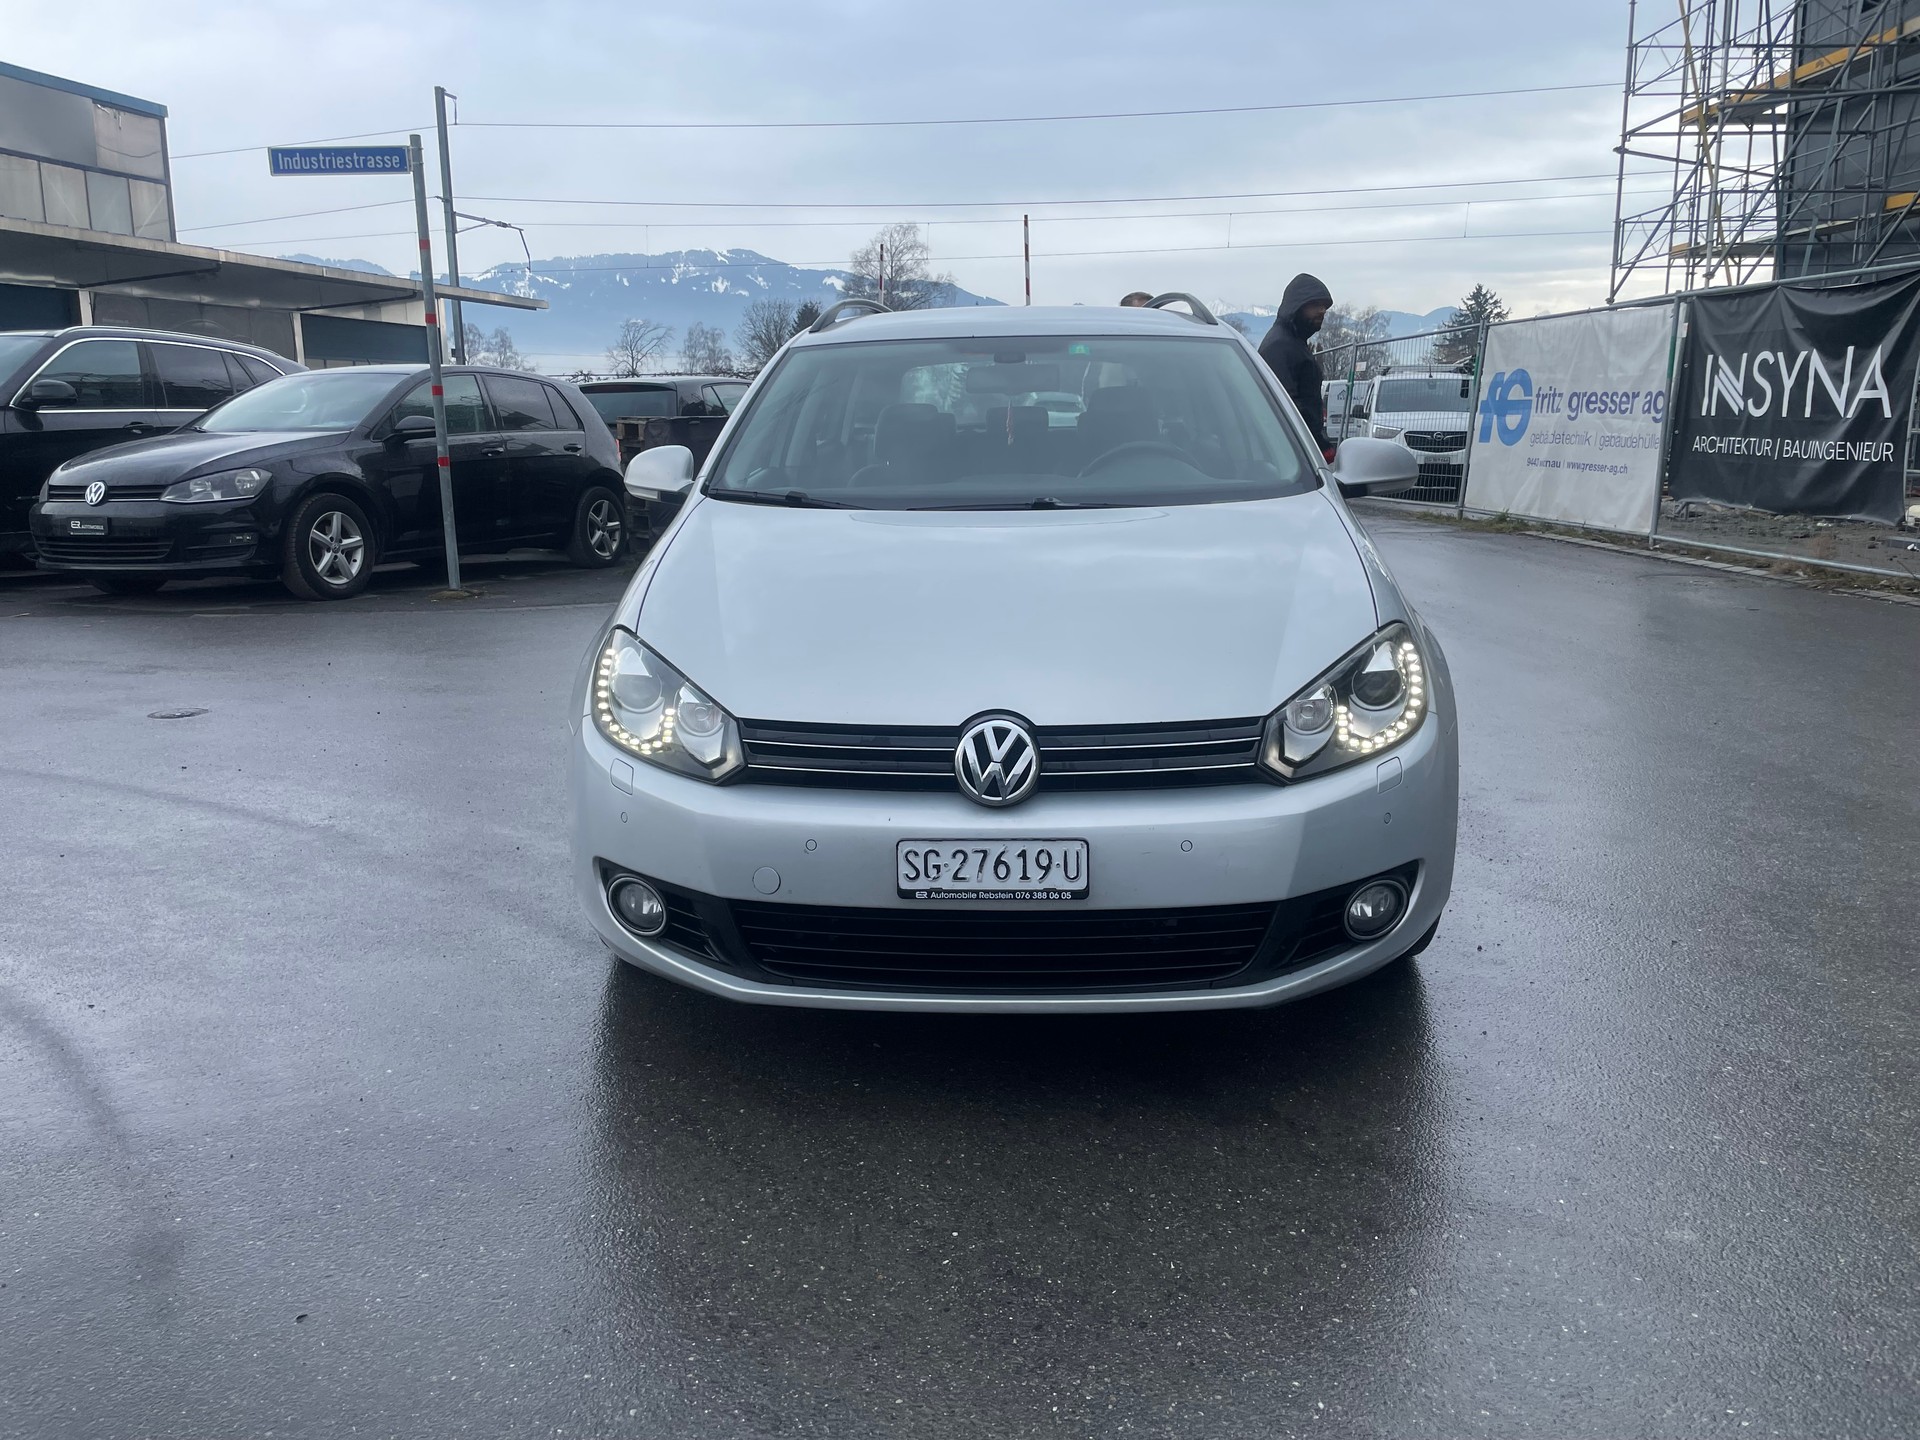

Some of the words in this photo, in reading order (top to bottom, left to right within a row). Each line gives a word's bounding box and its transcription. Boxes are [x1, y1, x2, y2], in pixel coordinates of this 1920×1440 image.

[278, 152, 400, 170] Industriestrasse
[1700, 344, 1892, 418] INSYNA
[1535, 386, 1563, 414] fritz
[1567, 390, 1640, 421] gresser
[1641, 389, 1665, 423] ag
[1692, 435, 1772, 456] ARCHITEKTUR
[1783, 439, 1894, 462] BAUINGENIEUR
[955, 719, 1037, 806] VW
[930, 891, 977, 899] Automobile
[978, 891, 1013, 899] Rebstein
[1015, 891, 1031, 899] 076
[1032, 891, 1047, 899] 388
[1049, 891, 1060, 899] 06
[1061, 891, 1072, 899] 05
